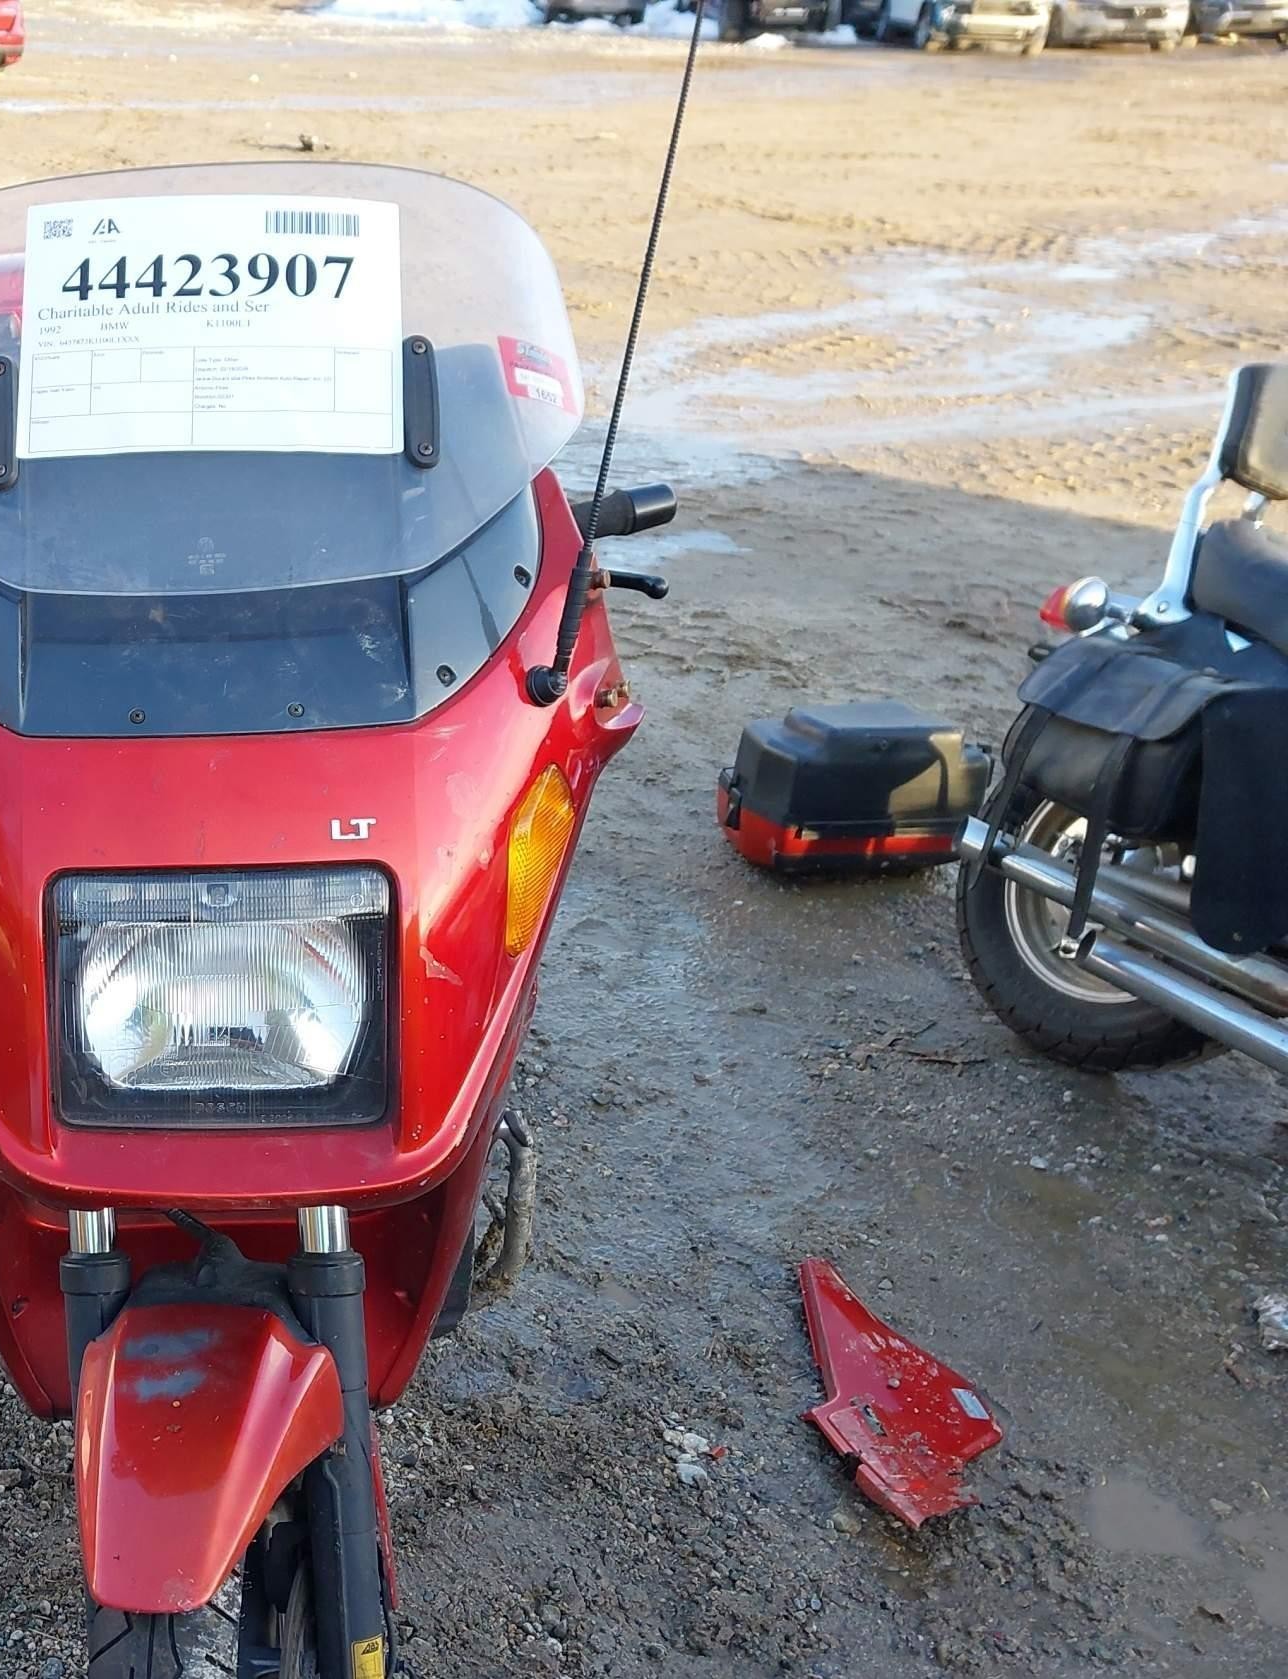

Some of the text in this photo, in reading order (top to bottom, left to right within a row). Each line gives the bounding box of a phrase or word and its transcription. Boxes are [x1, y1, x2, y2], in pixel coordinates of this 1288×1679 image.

[61, 252, 355, 301] 44423907
[37, 299, 270, 321] Charitable Adult Rides and Ser
[39, 325, 62, 336] 1992
[99, 320, 129, 332] BMW
[329, 817, 377, 840] LT
